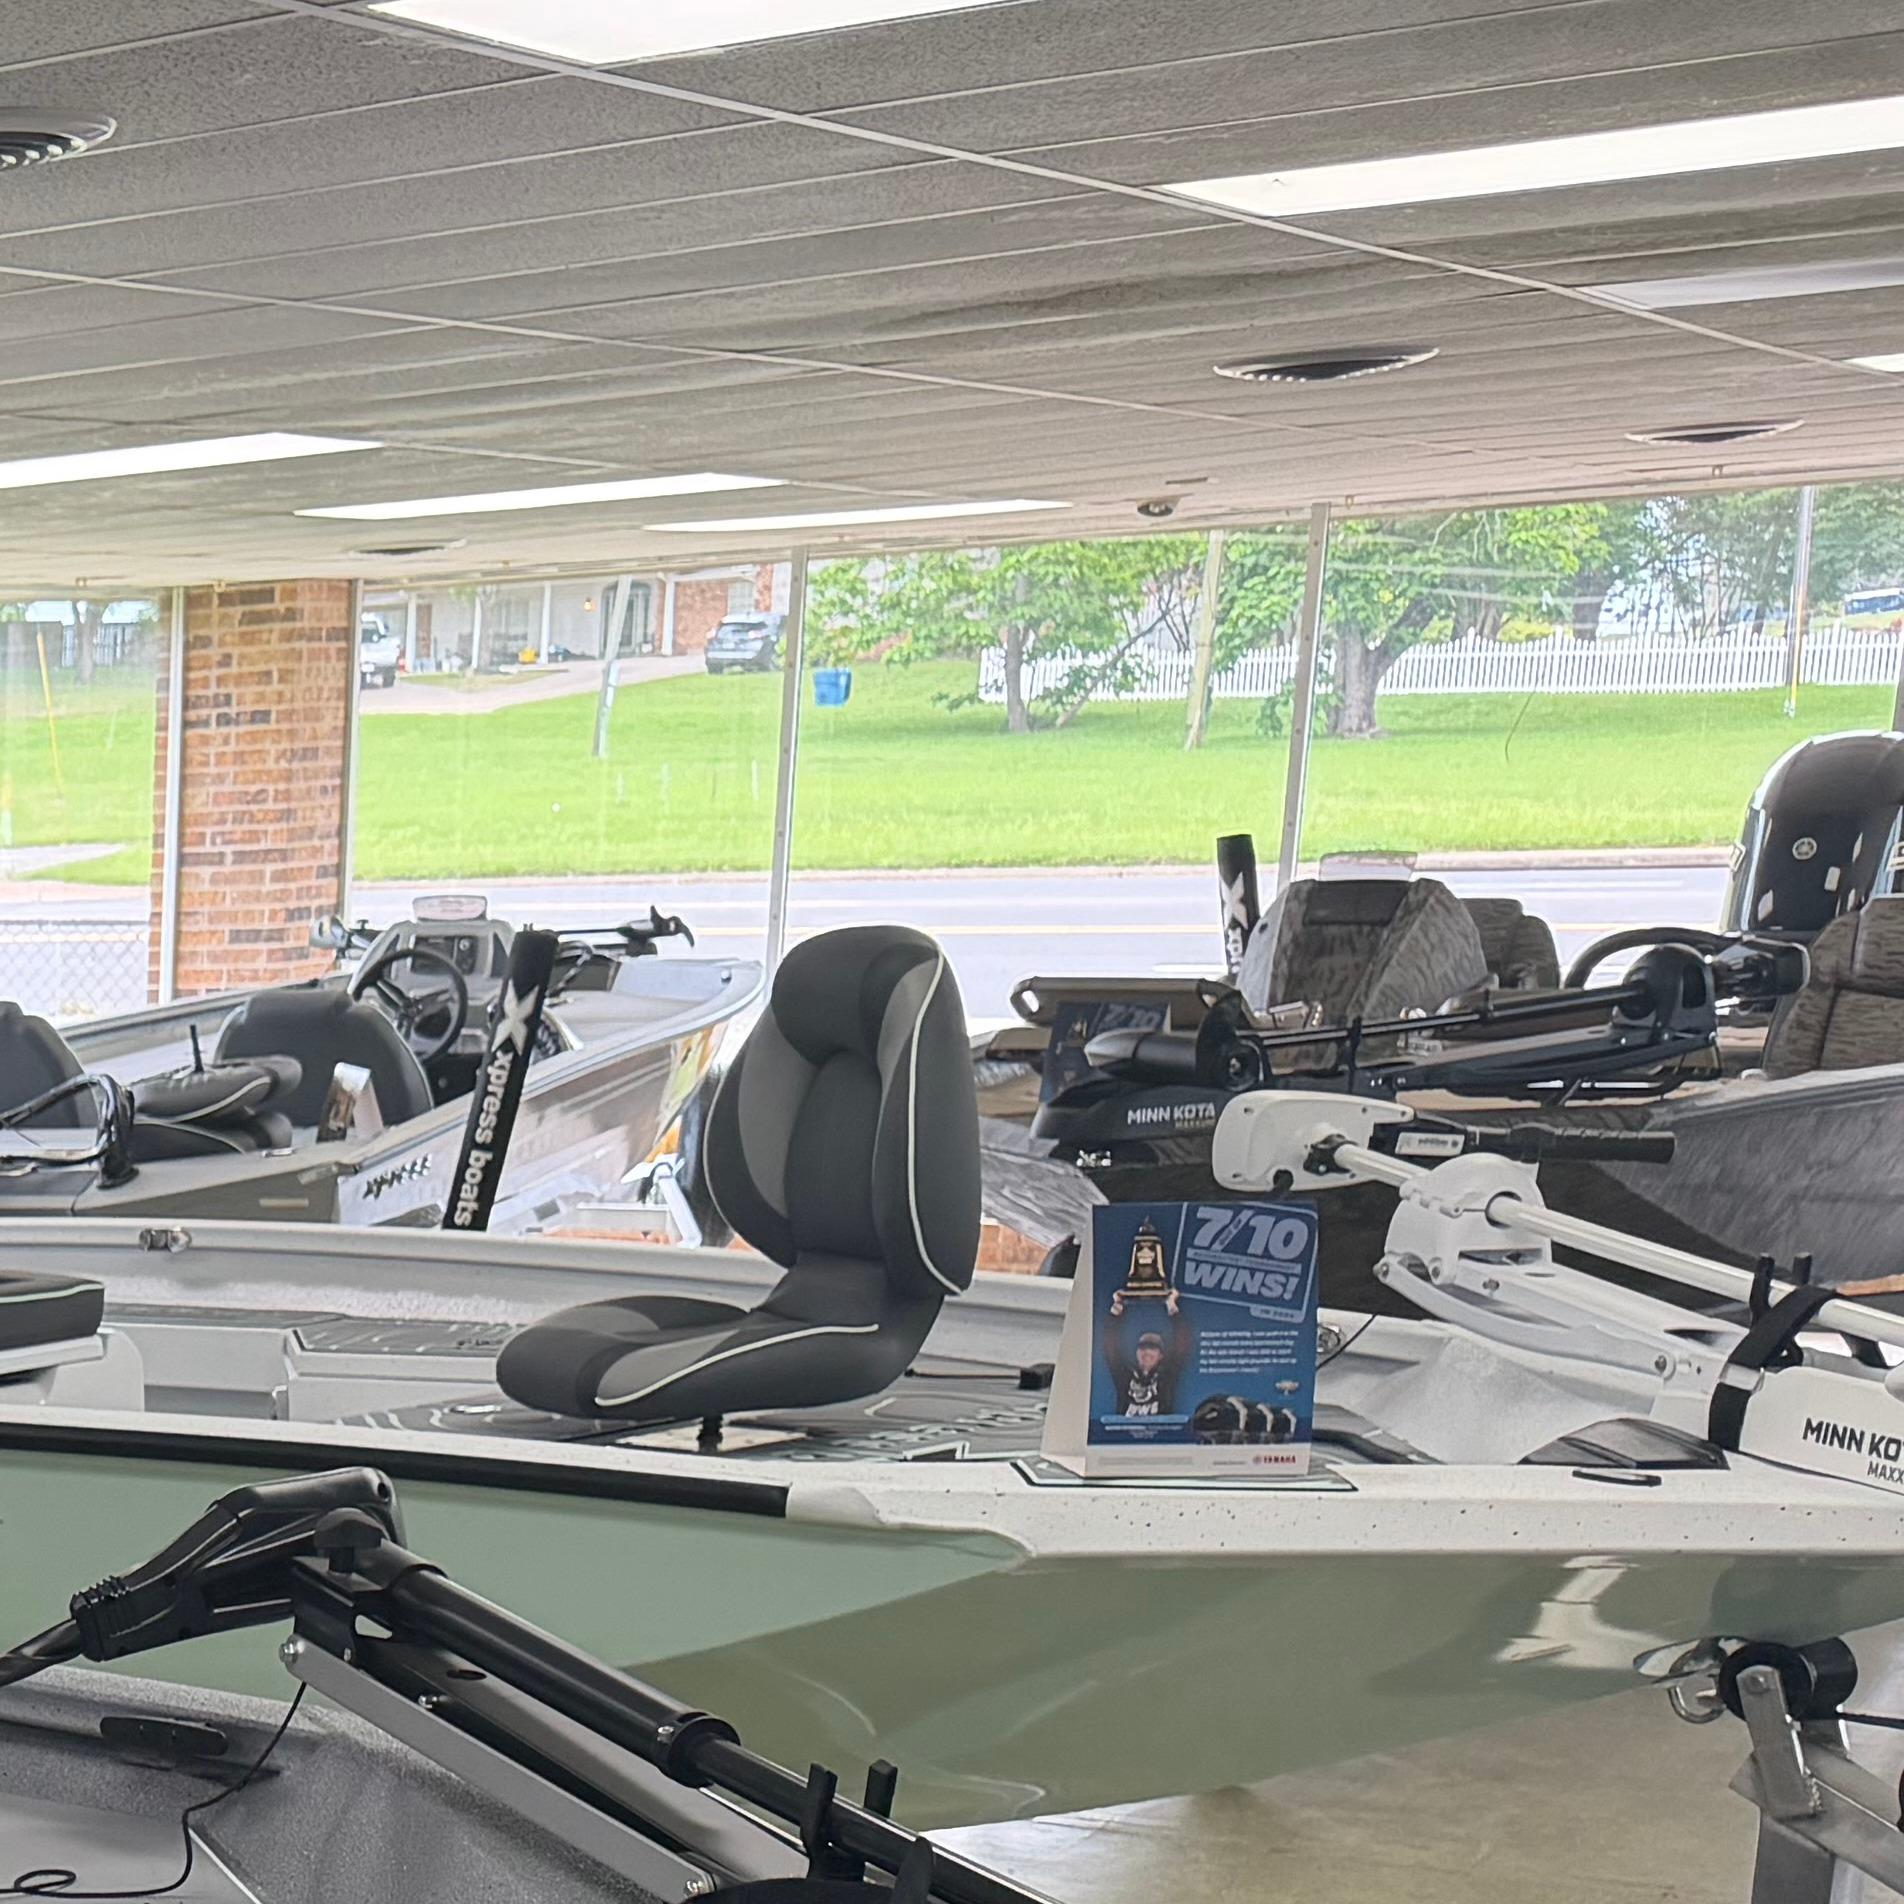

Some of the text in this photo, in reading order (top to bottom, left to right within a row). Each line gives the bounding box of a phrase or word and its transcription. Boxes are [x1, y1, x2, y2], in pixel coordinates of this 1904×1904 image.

[1127, 1102, 1216, 1125] MINN KOTA
[453, 1050, 514, 1227] xpress boats
[1194, 1206, 1309, 1260] 7/10
[1184, 1260, 1301, 1301] WINS!
[1263, 1454, 1297, 1464] YAMAHA
[1802, 1417, 1904, 1462] MINN KO
[1867, 1461, 1904, 1484] MAXX
